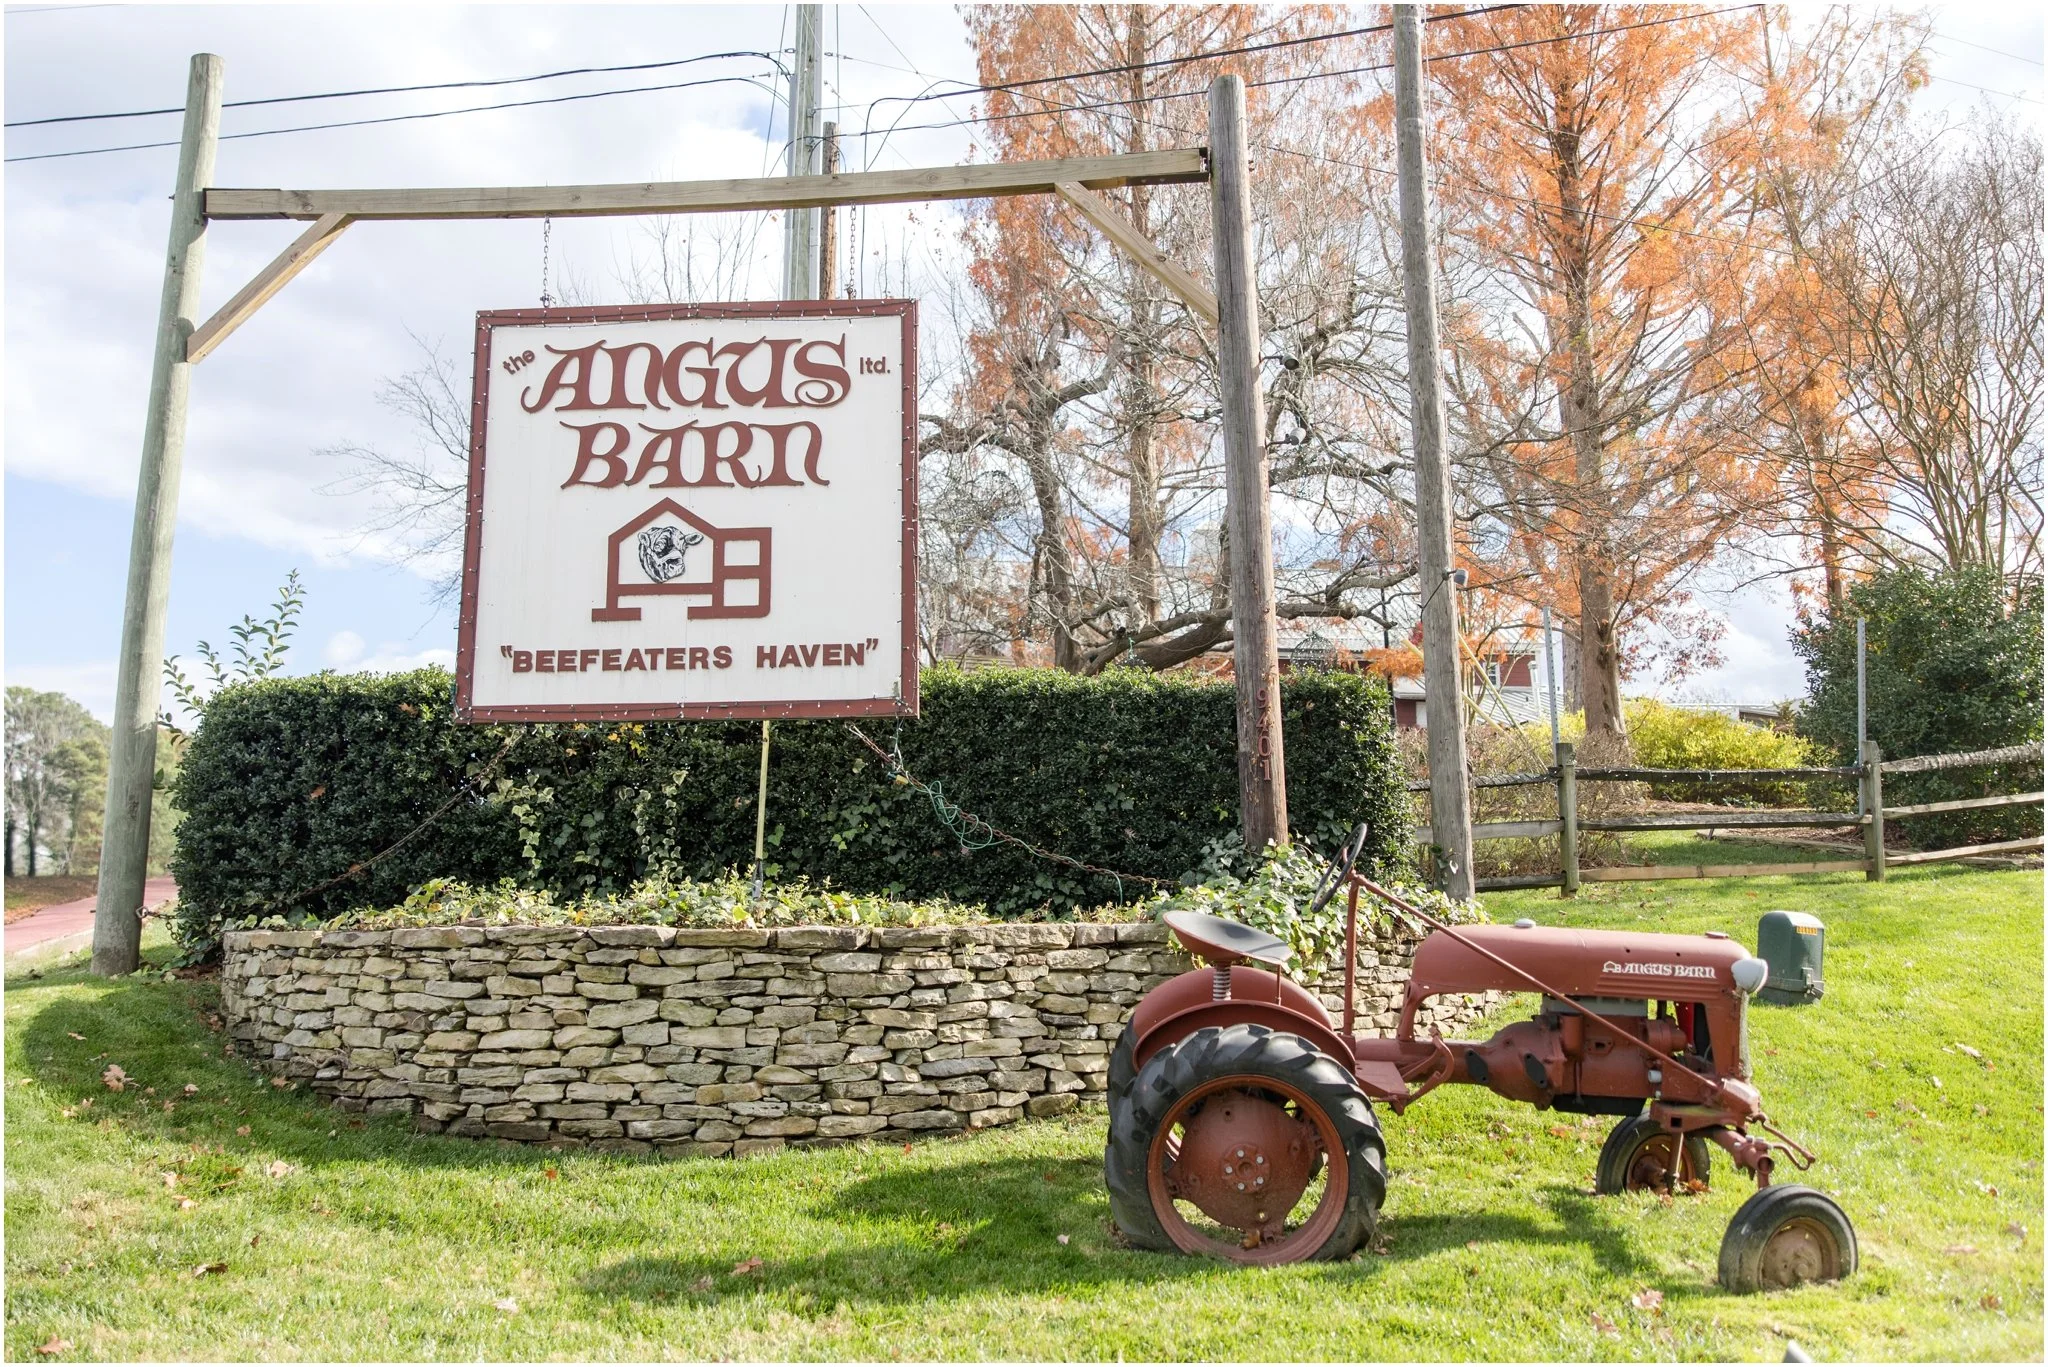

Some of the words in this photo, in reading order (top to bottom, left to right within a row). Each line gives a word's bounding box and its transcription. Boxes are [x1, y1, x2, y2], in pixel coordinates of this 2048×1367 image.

[502, 349, 536, 376] the
[520, 333, 851, 414] ANGUS
[859, 356, 891, 375] ltd.
[559, 419, 830, 489] BARN
[500, 645, 733, 673] "BEEFEATERS
[756, 638, 879, 669] HAVEN"
[1256, 688, 1271, 781] 9401
[1621, 962, 1673, 976] ANGUS
[1673, 964, 1718, 979] BARN
